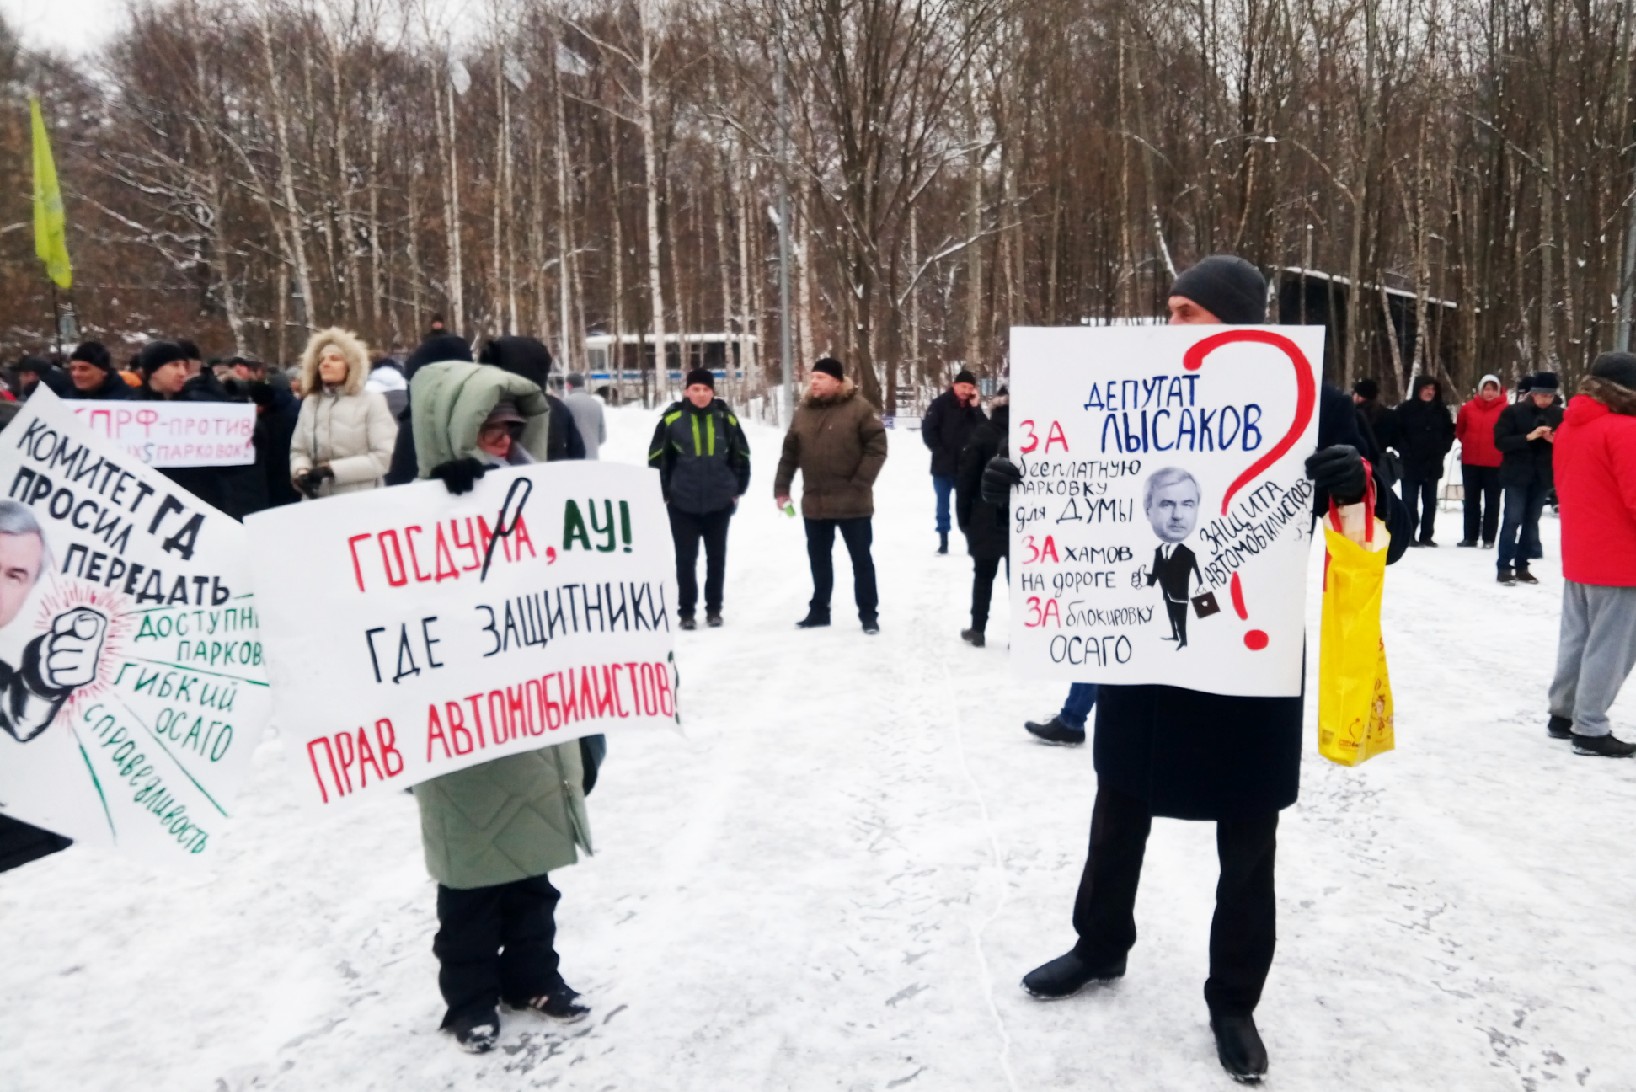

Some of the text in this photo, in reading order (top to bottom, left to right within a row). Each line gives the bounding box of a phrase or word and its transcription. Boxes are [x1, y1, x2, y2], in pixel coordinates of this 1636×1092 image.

[1084, 374, 1200, 411] ДЕПУТАТ
[74, 408, 253, 439] ПРФ-ПРОТИВ
[1019, 420, 1069, 454] ЗА
[1101, 404, 1263, 454] ЛЫСАКОВ
[8, 466, 134, 555] ПРОСИЛ
[17, 417, 207, 561] КОМИТЕТ ГД
[1055, 497, 1133, 525] ДУМЫ
[563, 498, 634, 554] АУ!
[1200, 480, 1284, 555] ЗАЩИТА
[61, 542, 231, 607] ПЕРЕДАТЬ
[1022, 535, 1060, 565] ЗА
[1021, 572, 1046, 592] НА
[134, 606, 259, 643] ДОСТУПН
[365, 582, 670, 684] ГДЕ ЗАЩИТНИКИ
[1024, 595, 1062, 629] ЗА
[1049, 634, 1132, 667] ОСАГО
[114, 662, 238, 712] ГИБКИЙ
[156, 707, 234, 762] ОСАГО
[83, 703, 209, 854] справедливость
[306, 718, 404, 804] ПРАВ
